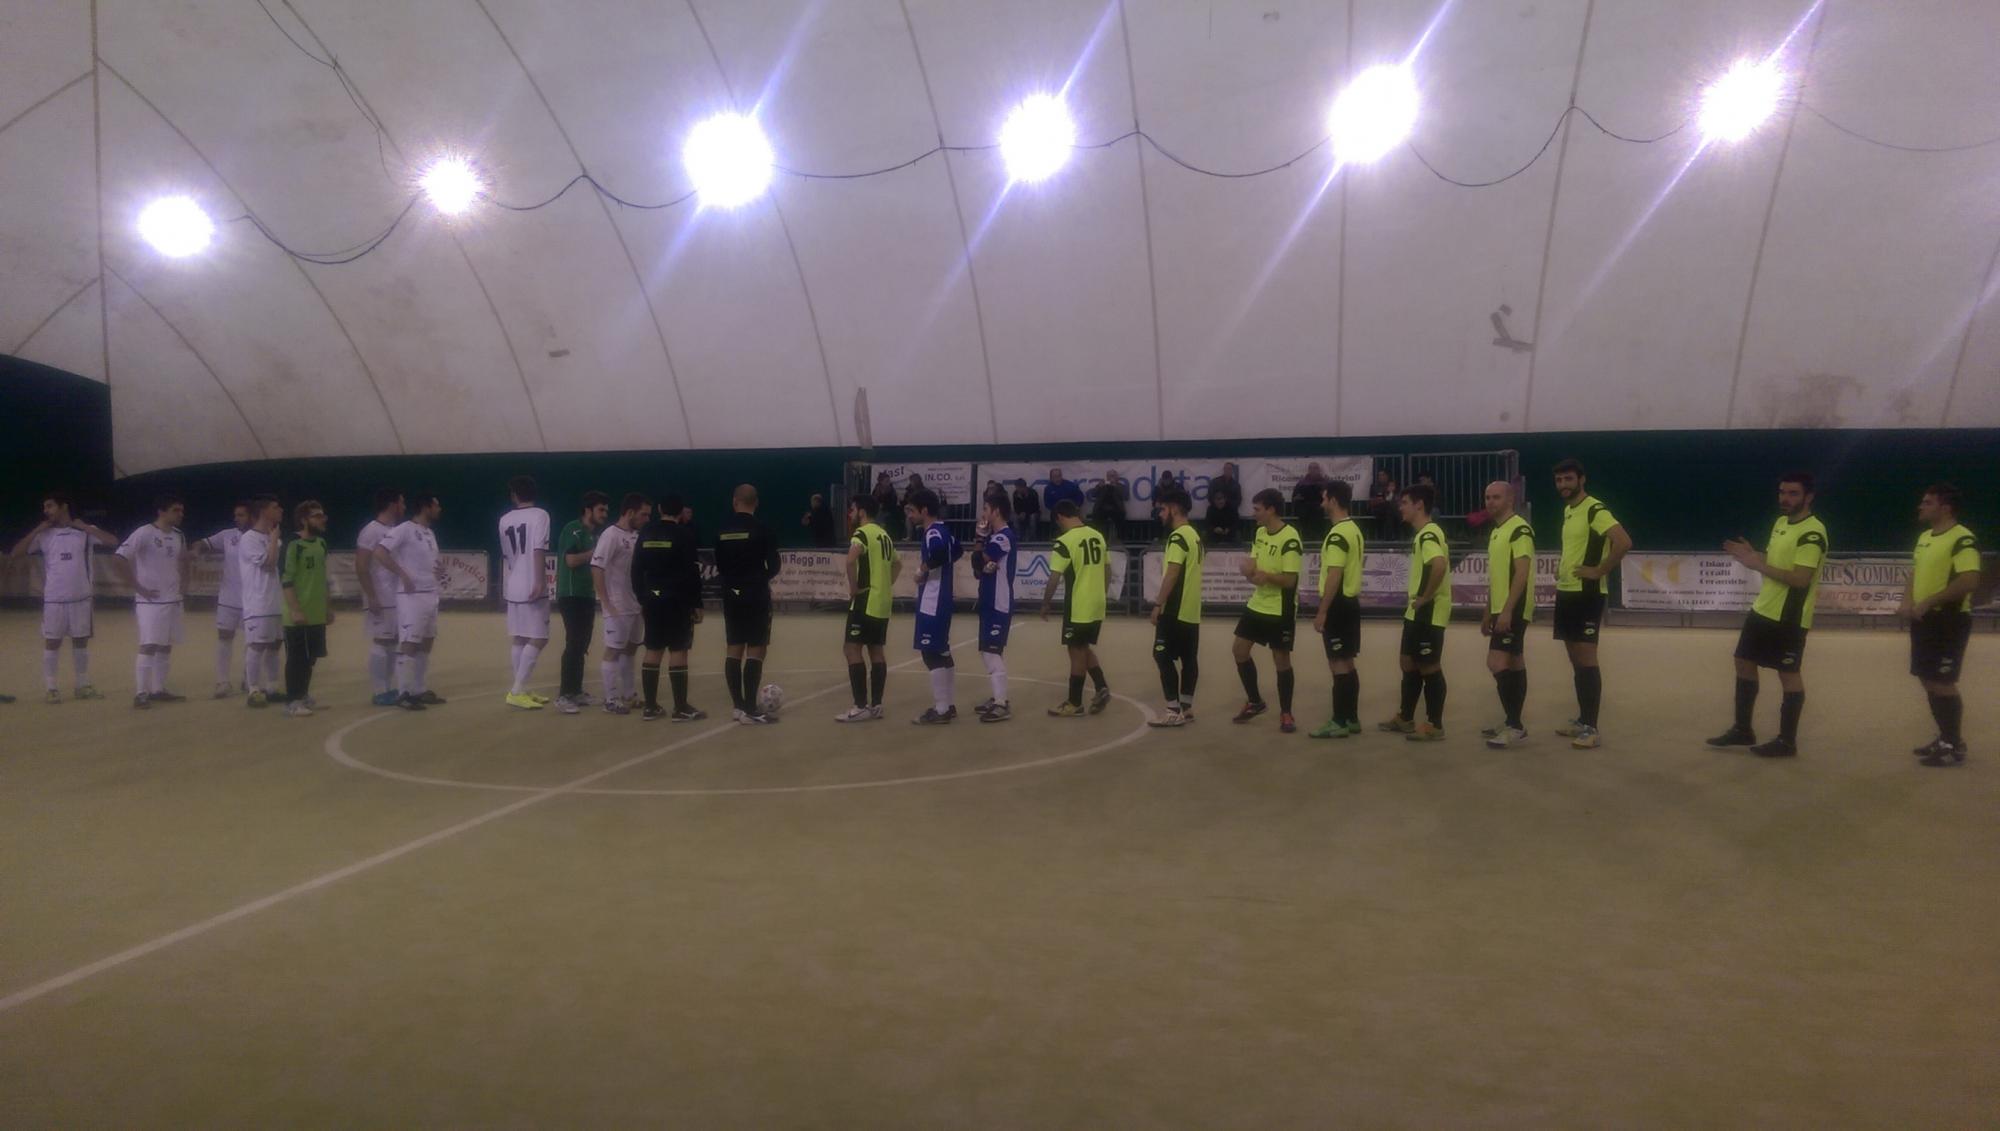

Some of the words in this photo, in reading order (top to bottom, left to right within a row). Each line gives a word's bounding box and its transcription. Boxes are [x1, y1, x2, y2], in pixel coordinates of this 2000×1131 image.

[504, 522, 527, 555] 11
[877, 533, 893, 562] 10
[1078, 537, 1102, 566] 16
